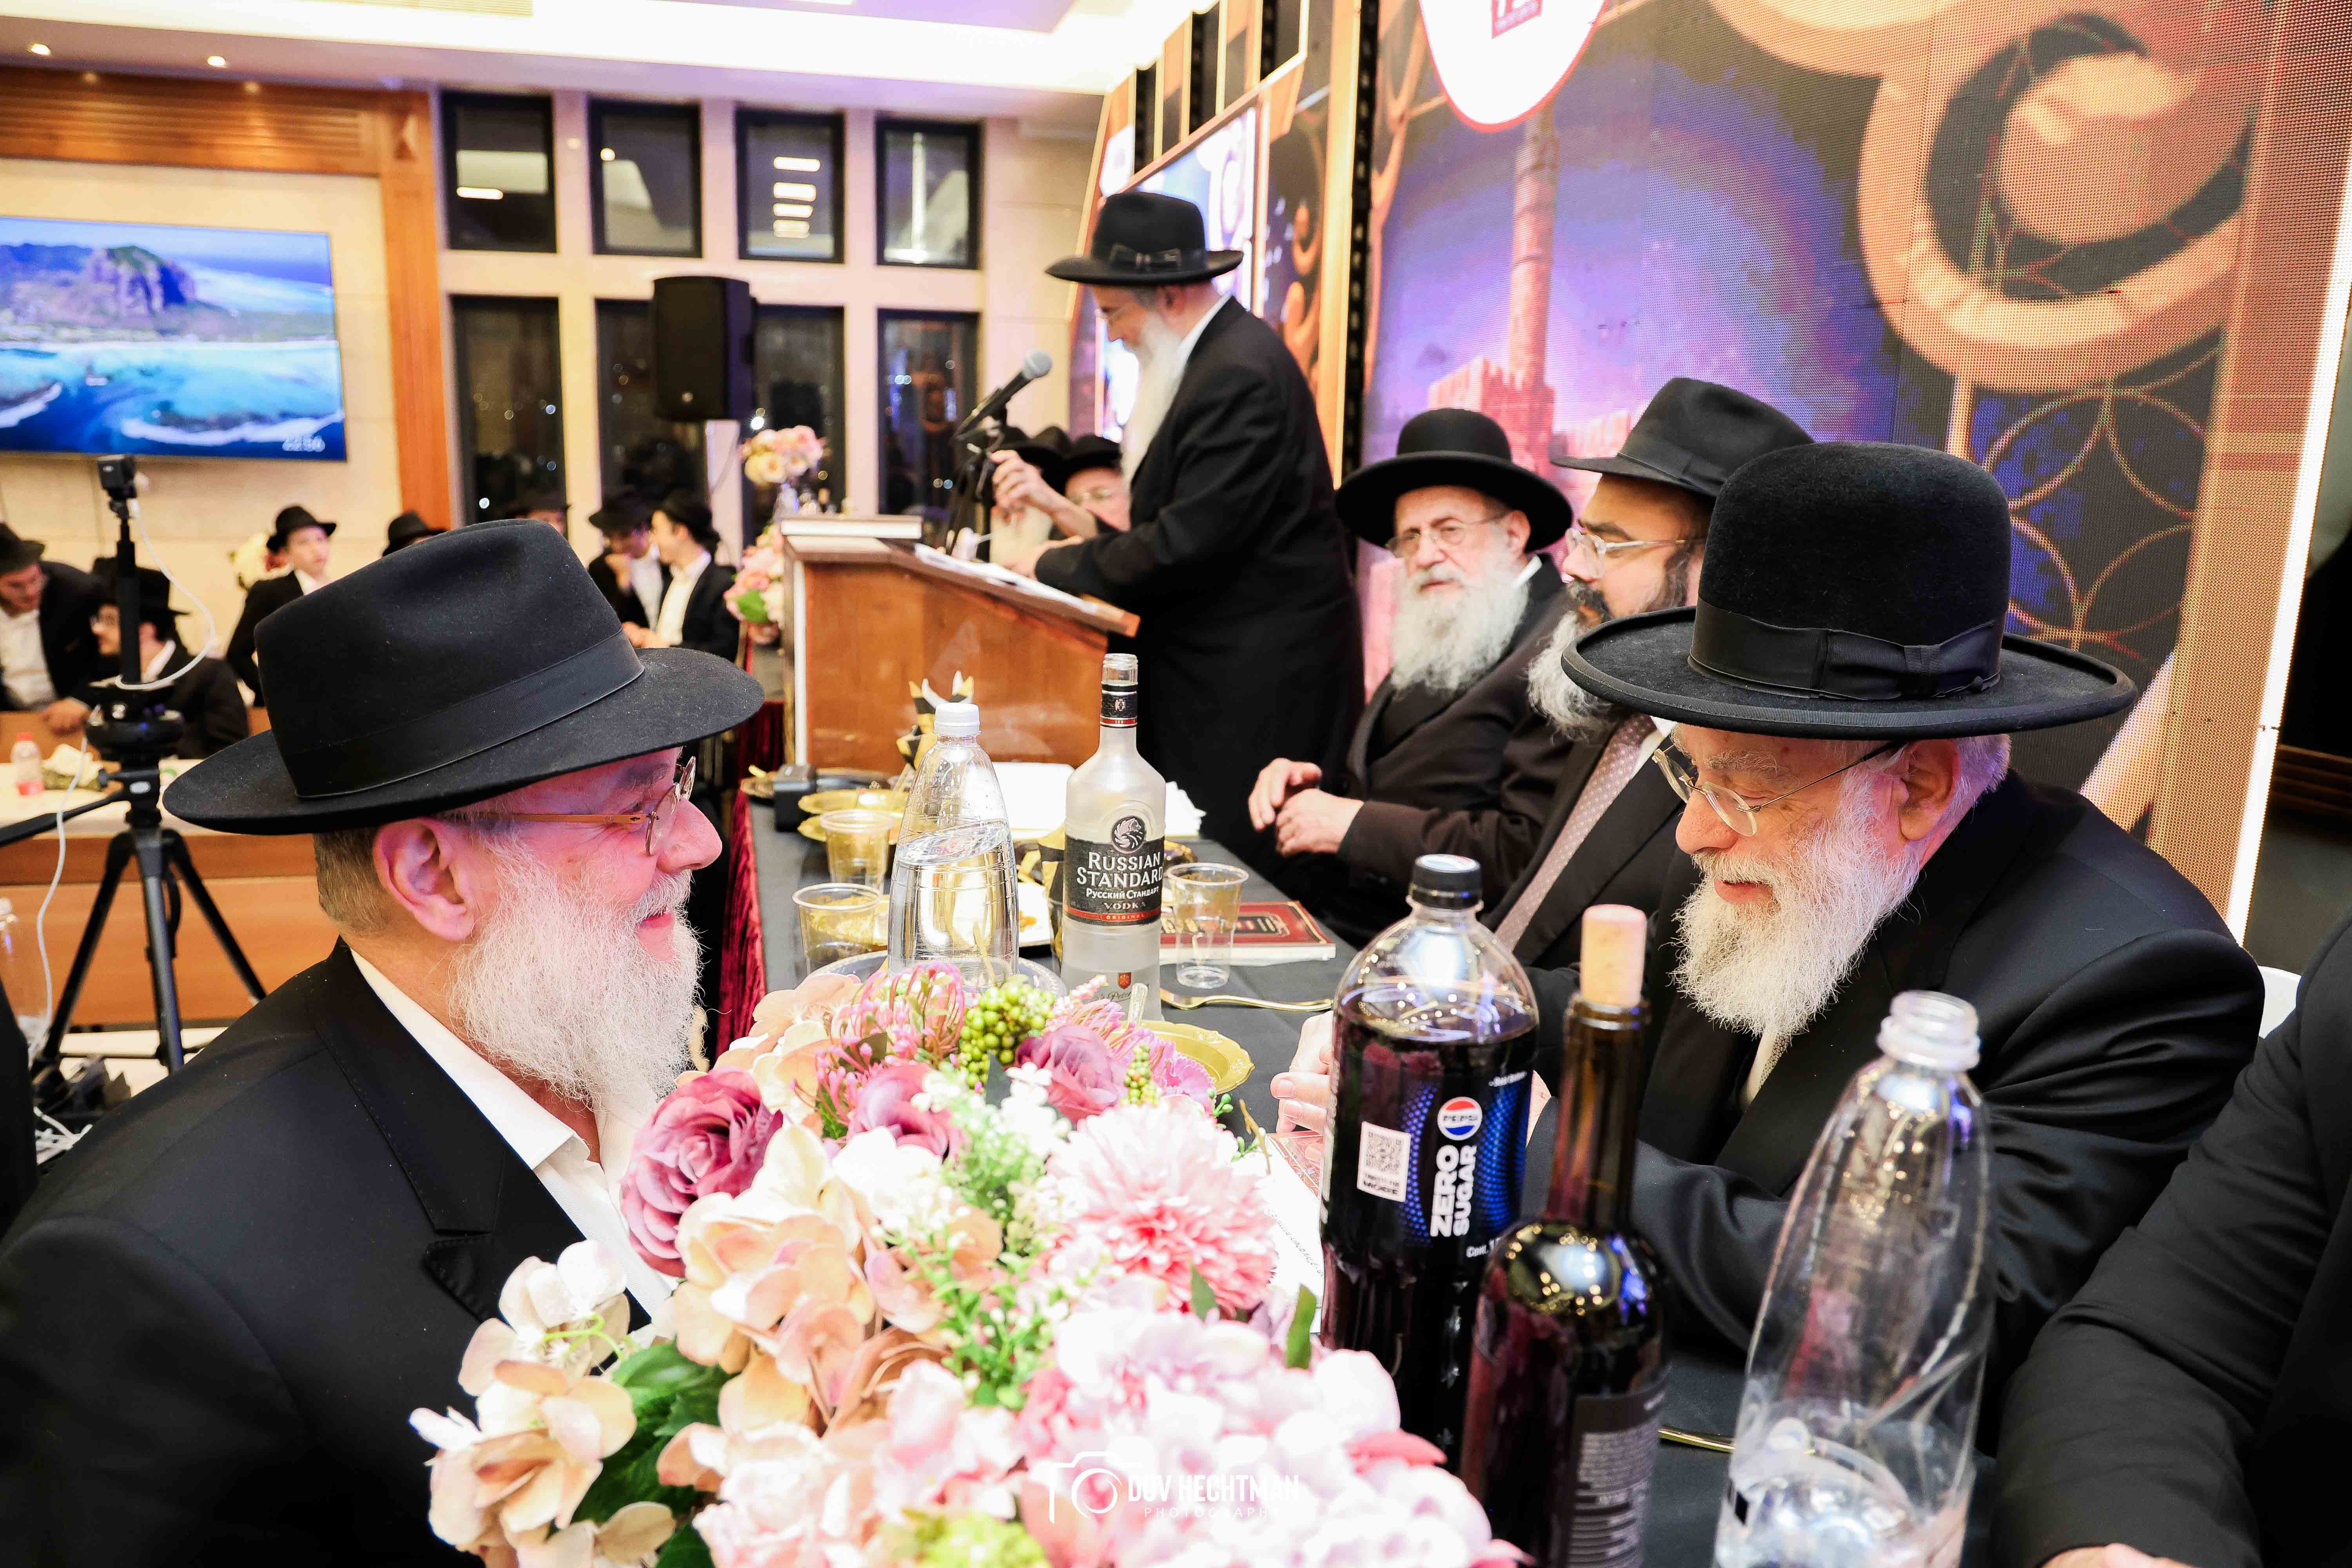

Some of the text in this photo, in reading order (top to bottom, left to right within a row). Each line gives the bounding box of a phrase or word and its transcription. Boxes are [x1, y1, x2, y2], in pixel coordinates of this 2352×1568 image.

[1076, 866, 1163, 888] STANDARD
[1088, 851, 1160, 871] RUSSIAN
[1430, 1145, 1459, 1237] ZERO
[1453, 1145, 1477, 1236] SUGAR
